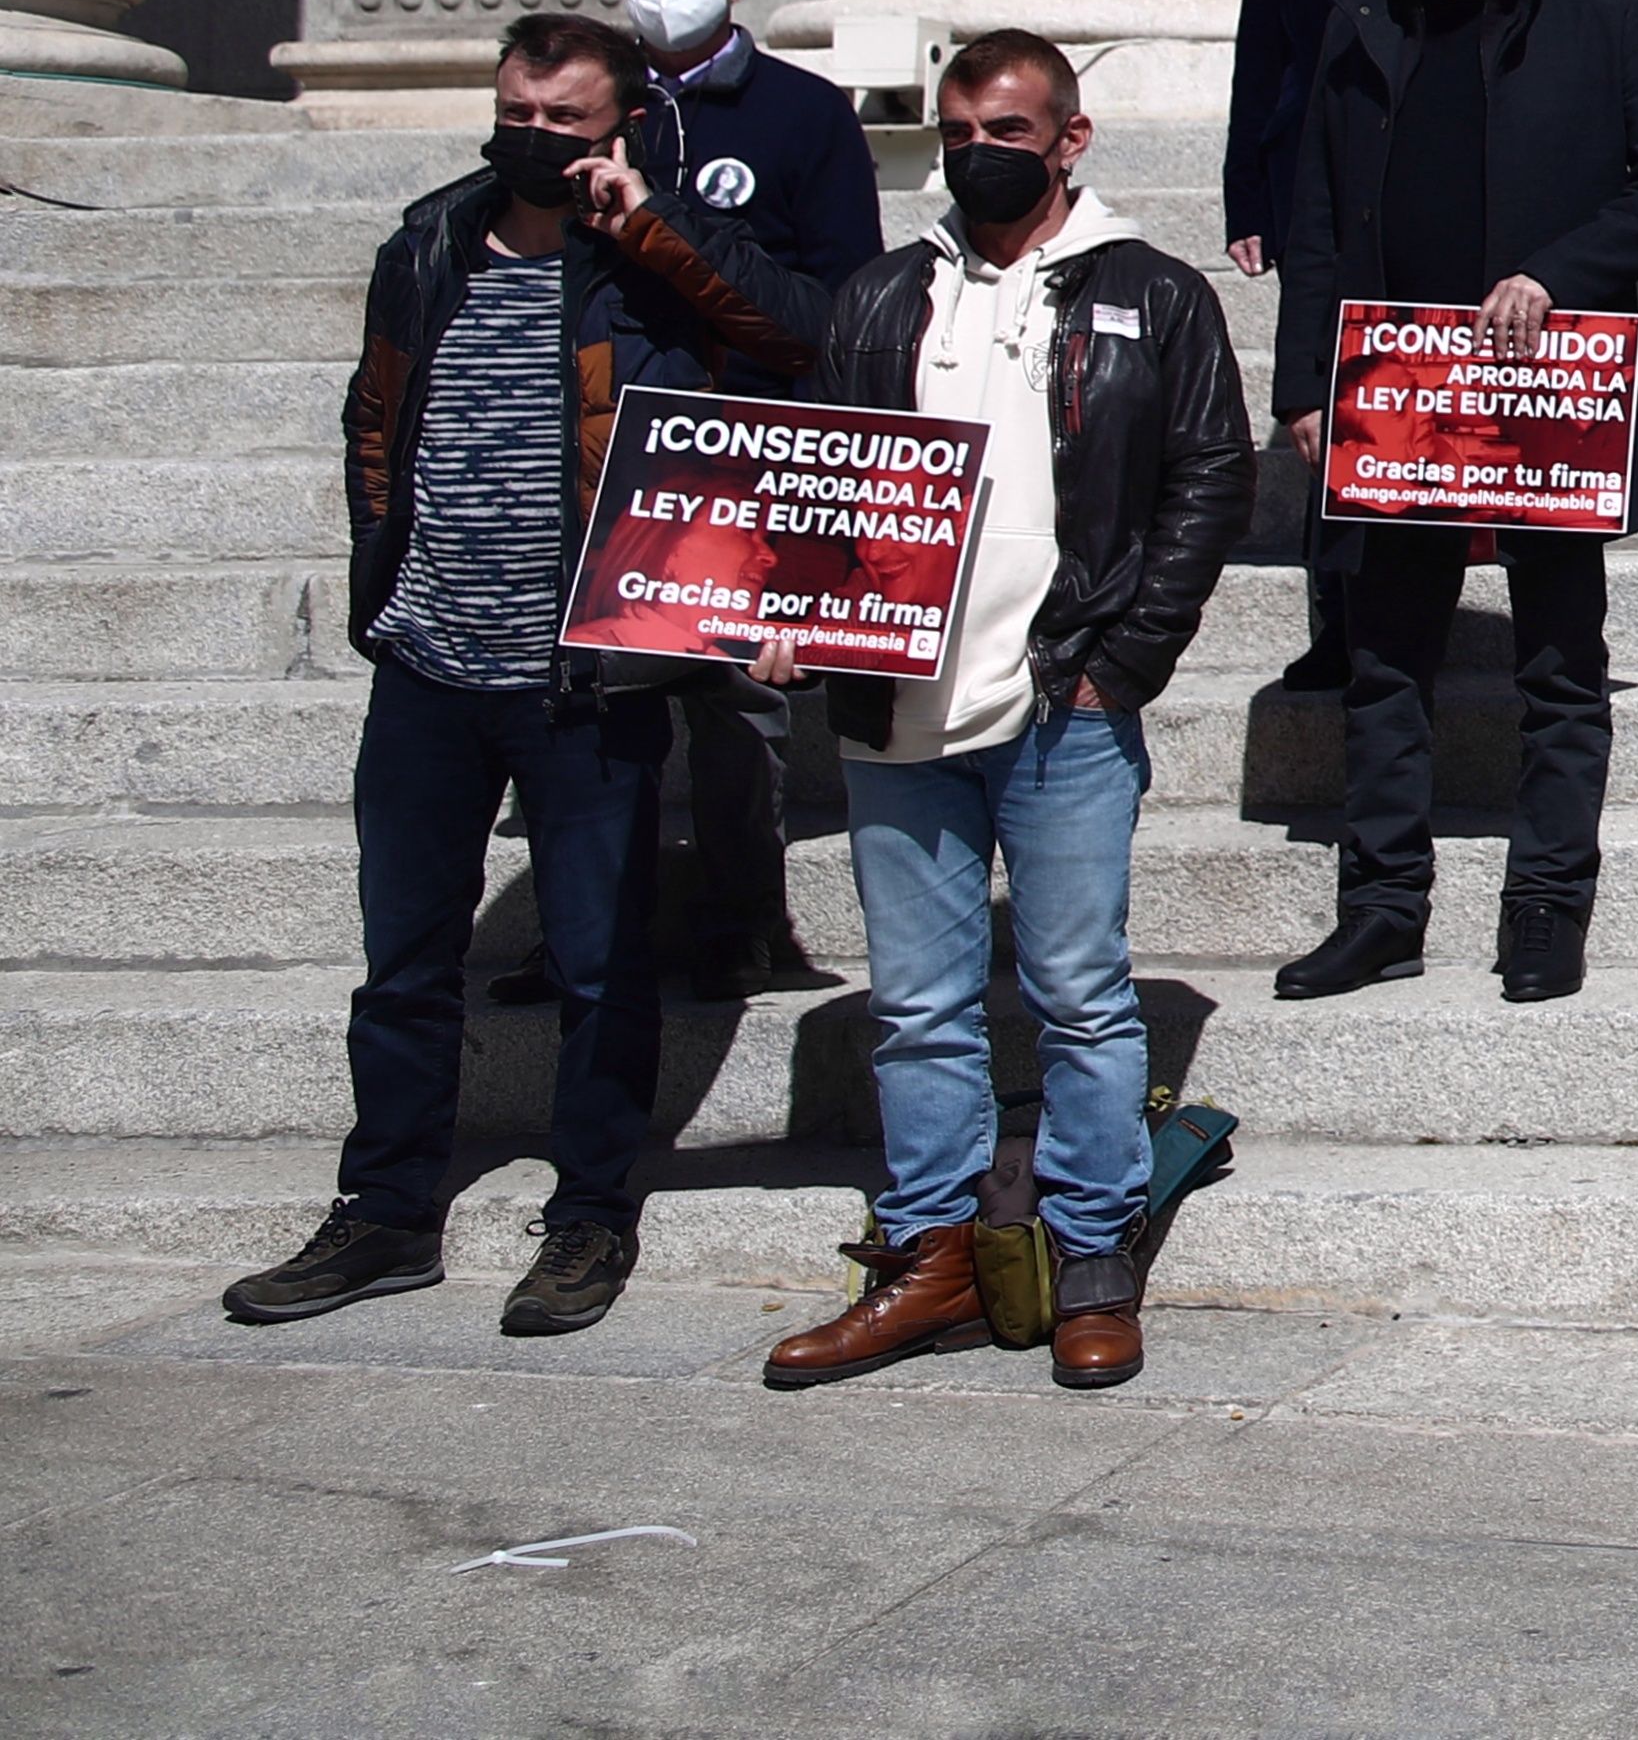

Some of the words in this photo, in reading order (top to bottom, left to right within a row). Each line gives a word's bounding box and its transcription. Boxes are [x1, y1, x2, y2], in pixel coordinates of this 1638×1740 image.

[1447, 364, 1586, 390] APROBADA
[1593, 371, 1626, 393] LA
[1356, 387, 1409, 411] LEY
[1416, 389, 1452, 413] DE
[1460, 390, 1624, 421] EUTANASIA
[644, 416, 969, 477] ¡CONSEGUIDO!
[1356, 455, 1455, 482] Gracias
[1463, 465, 1507, 488] por
[1515, 464, 1542, 486] tu
[1550, 463, 1621, 489] firma
[755, 471, 914, 507] APROBADA
[922, 485, 962, 511] LA
[1341, 484, 1594, 510] change.org/AngelNoEsCulpable
[629, 490, 703, 522] LEY
[710, 498, 757, 530] DE
[766, 504, 956, 546] EUTANASIA
[617, 572, 750, 612] Gracias
[757, 592, 810, 619] por
[820, 592, 851, 619] tu
[859, 593, 941, 627] firma
[697, 617, 905, 652] change.org/eutanasia
